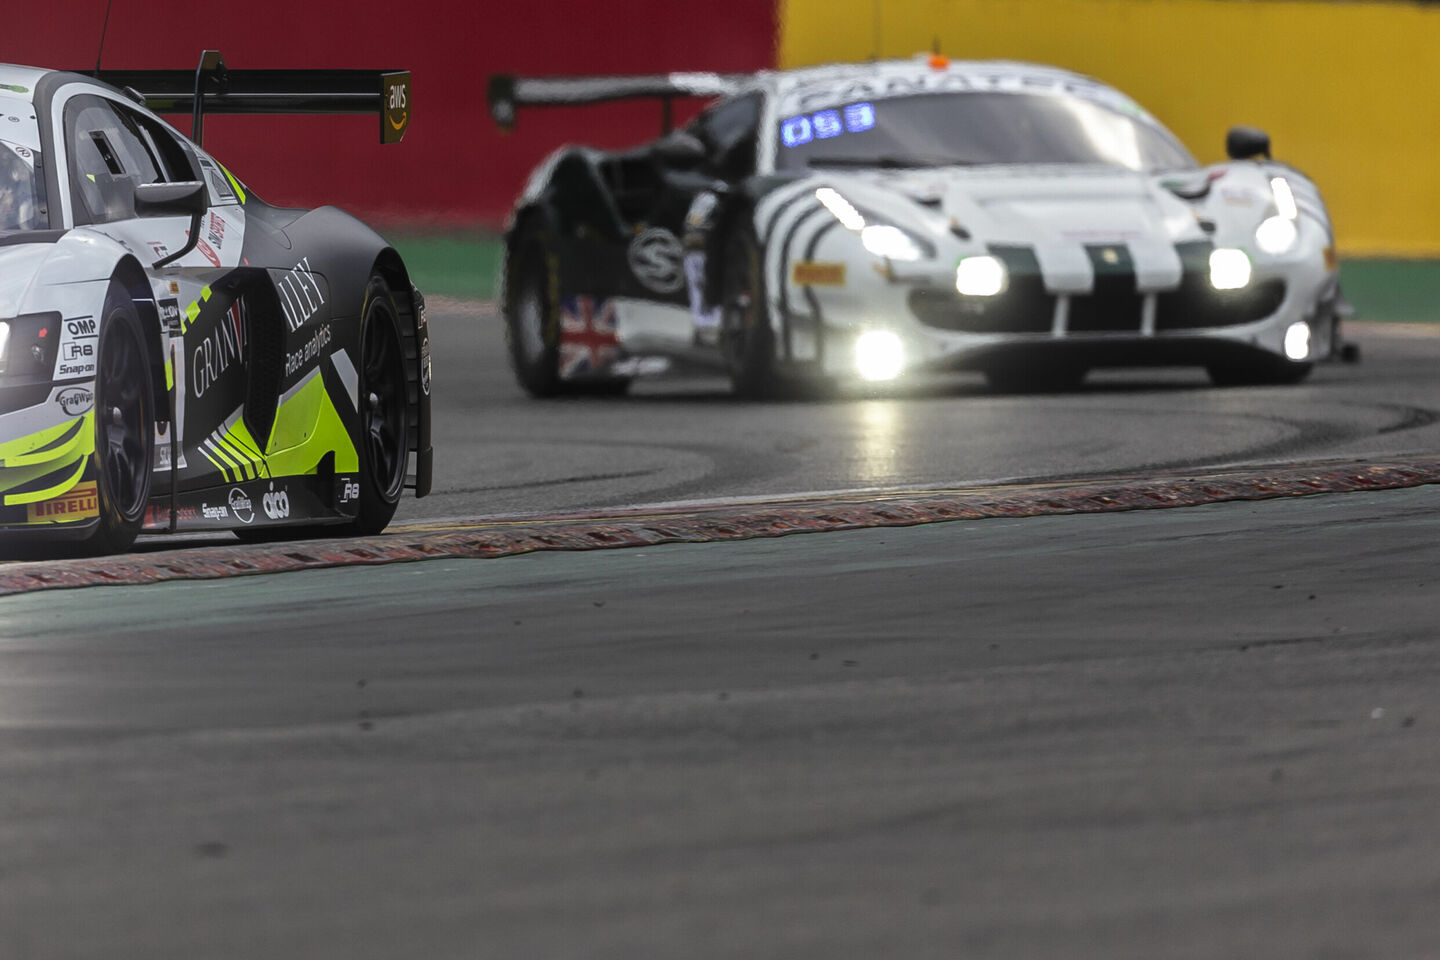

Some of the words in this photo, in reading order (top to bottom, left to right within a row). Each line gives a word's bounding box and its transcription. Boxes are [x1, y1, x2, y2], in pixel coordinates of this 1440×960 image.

[390, 84, 406, 109] aws
[67, 319, 97, 336] OMP
[71, 343, 94, 358] R8
[285, 351, 305, 378] Race
[304, 323, 333, 358] analytics
[59, 364, 95, 375] Snap-on
